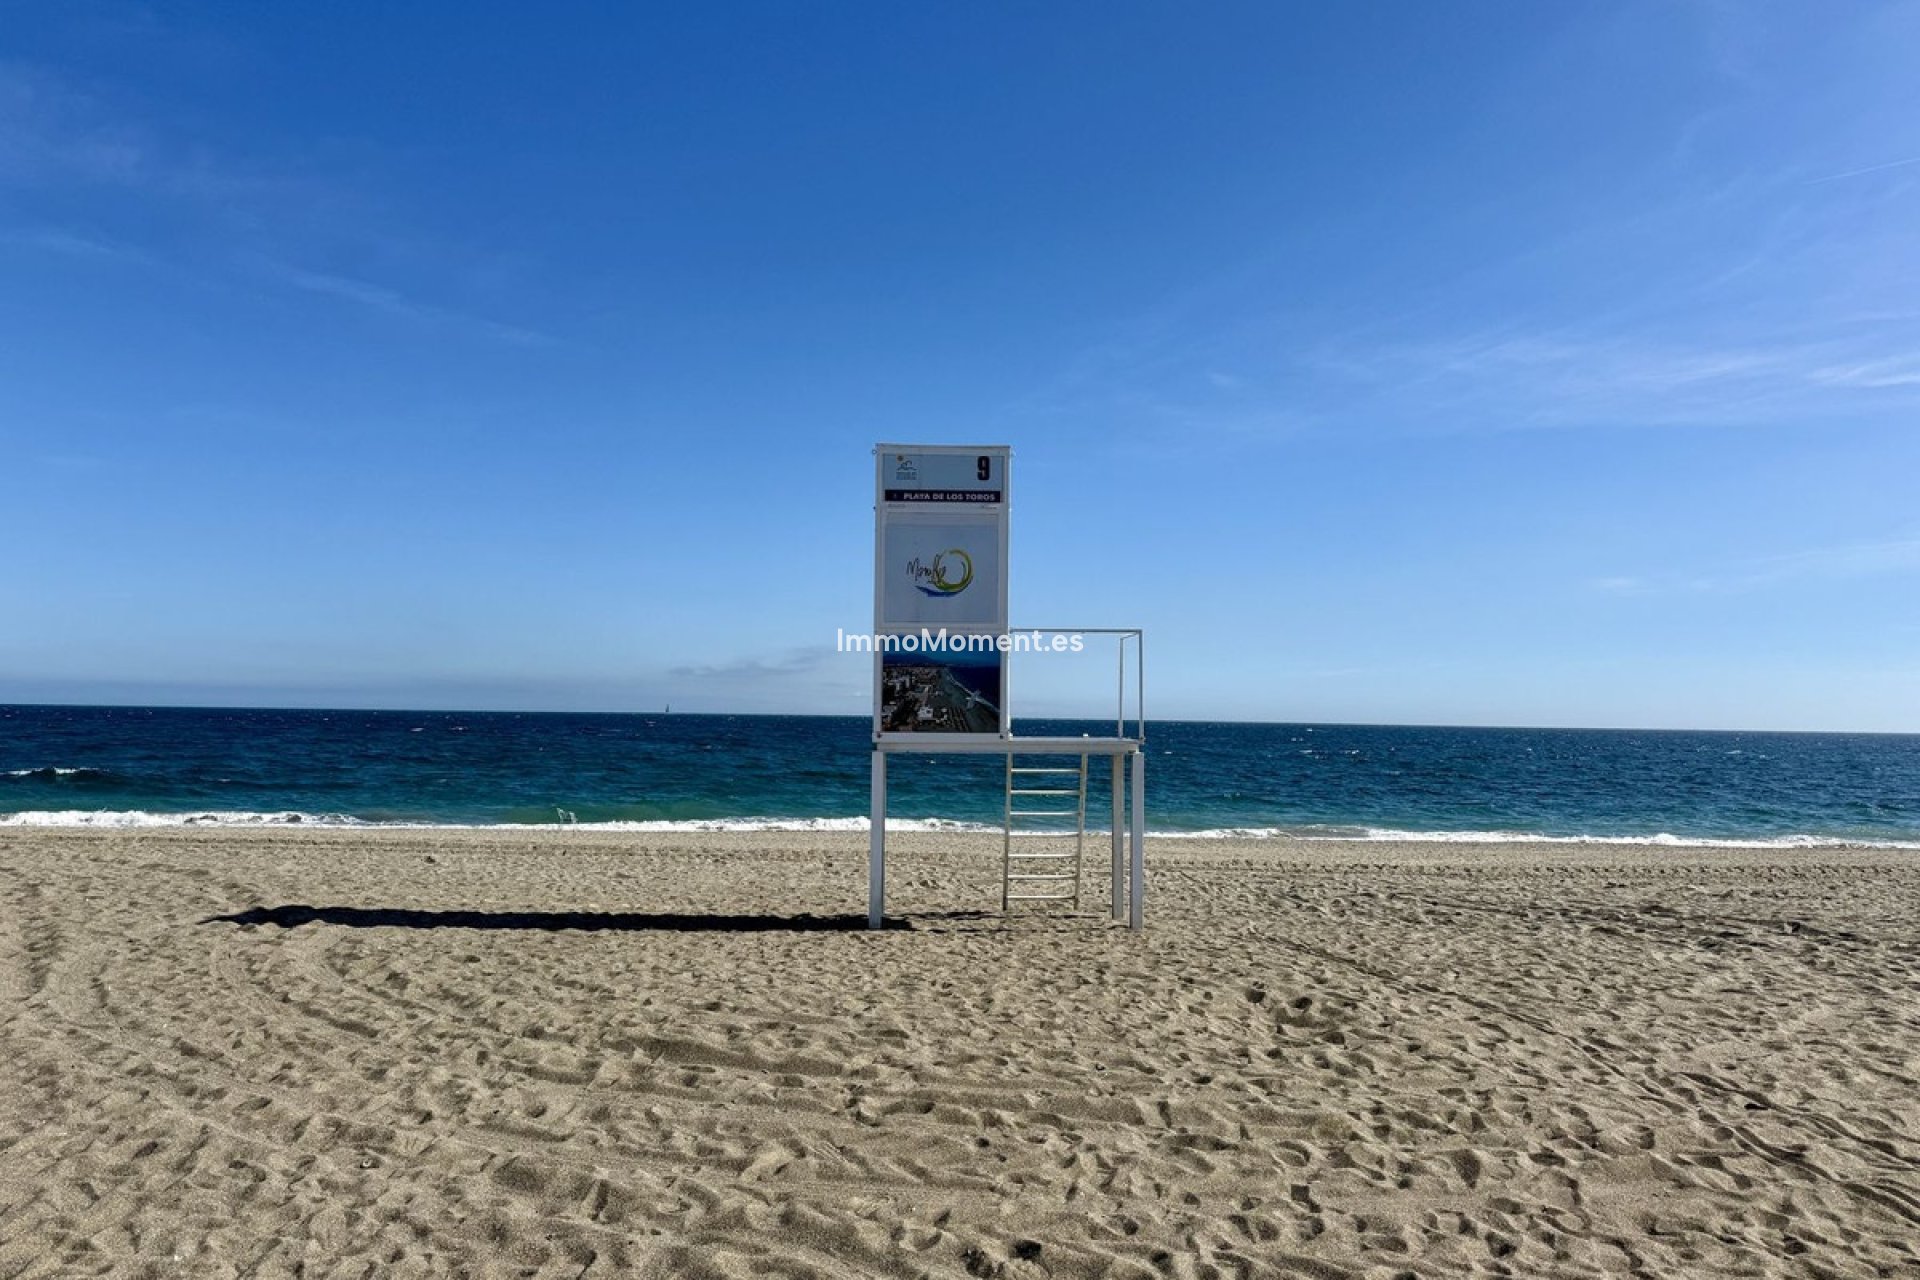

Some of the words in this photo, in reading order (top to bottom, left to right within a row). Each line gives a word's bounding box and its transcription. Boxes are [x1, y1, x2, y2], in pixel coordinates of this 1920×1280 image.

[977, 455, 990, 481] 9
[903, 492, 930, 500] PLAYA
[932, 492, 944, 500] DE
[946, 492, 963, 500] LOS
[965, 493, 996, 501] TOROS
